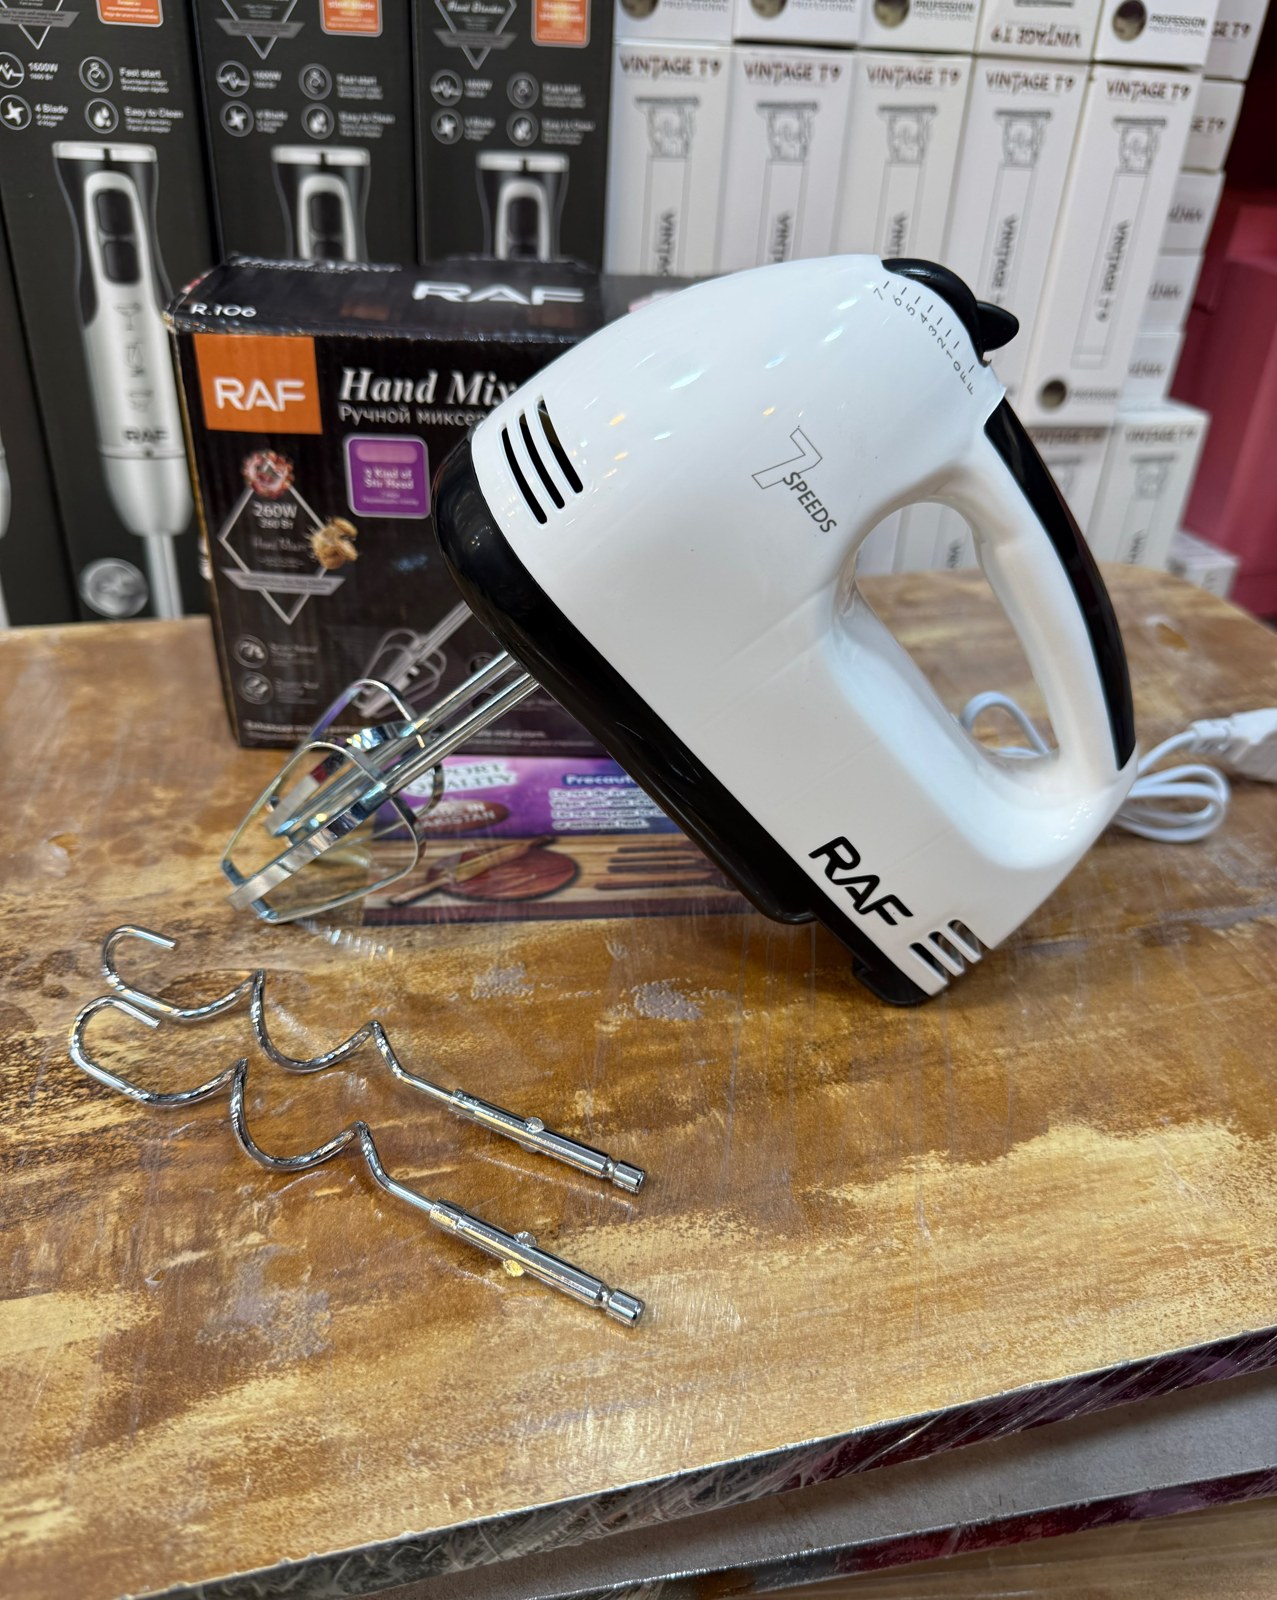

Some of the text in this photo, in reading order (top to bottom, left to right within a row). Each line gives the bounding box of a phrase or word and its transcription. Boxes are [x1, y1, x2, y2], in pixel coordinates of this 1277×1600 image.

[619, 55, 693, 80] VINTAGE
[744, 60, 814, 85] VINTAGE
[867, 65, 933, 89] VINTAGE
[985, 70, 1051, 94] VINTAGE
[1106, 78, 1166, 101] VINTAGE
[411, 280, 586, 306] RAF
[873, 287, 884, 301] 7
[892, 294, 902, 307] 6
[189, 304, 258, 319] R.106
[905, 303, 916, 316] 5
[920, 312, 929, 324] 4
[928, 324, 938, 337] 3
[936, 337, 946, 350] 2
[945, 349, 953, 360] 1
[213, 377, 306, 412] RAF
[338, 366, 438, 404] Hand
[337, 402, 411, 427] Ручной
[751, 426, 823, 490] 7
[781, 471, 837, 533] SPEEDS
[808, 836, 914, 926] RAF
